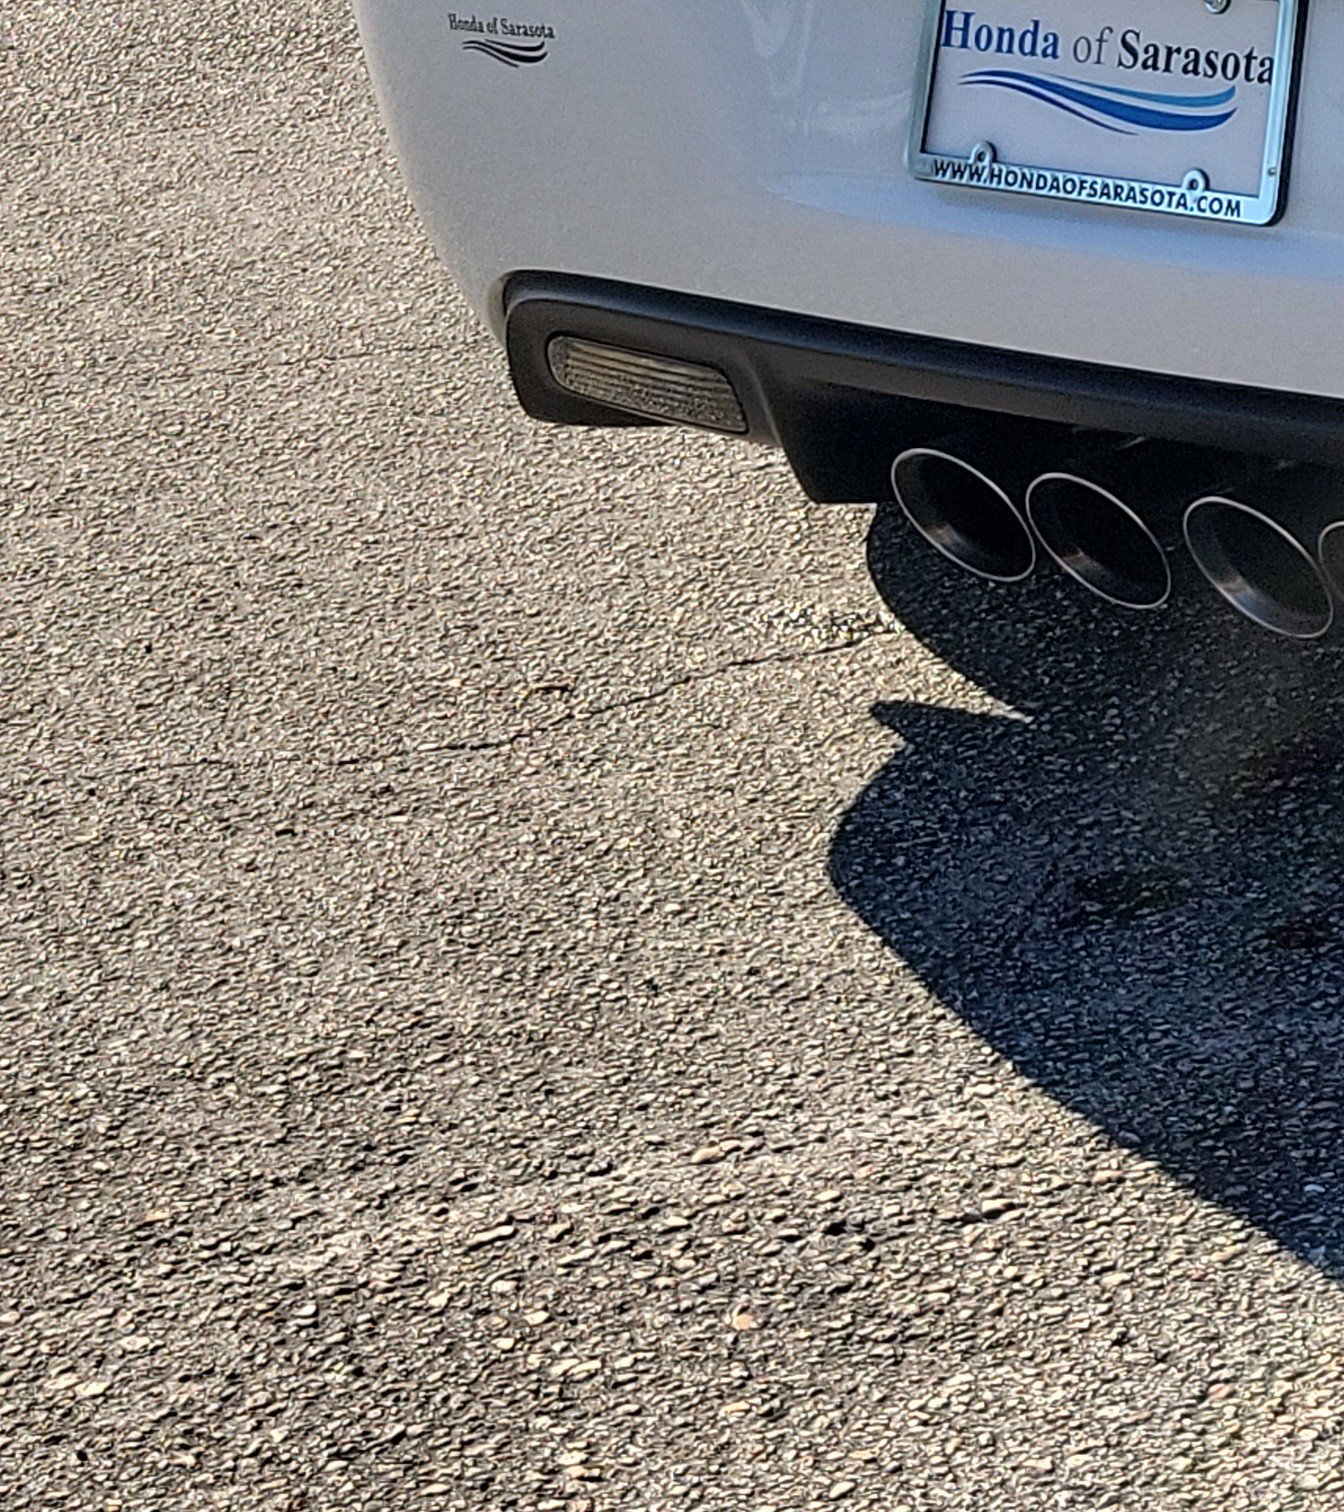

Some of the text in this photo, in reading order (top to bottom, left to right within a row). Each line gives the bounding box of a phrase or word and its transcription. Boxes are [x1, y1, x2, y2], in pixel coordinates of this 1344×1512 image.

[448, 13, 556, 39] Honda of Sarasota
[940, 9, 1275, 85] Honda of Sarasota
[933, 159, 1242, 218] WWW.HONDAOFSARASOTA.COM
